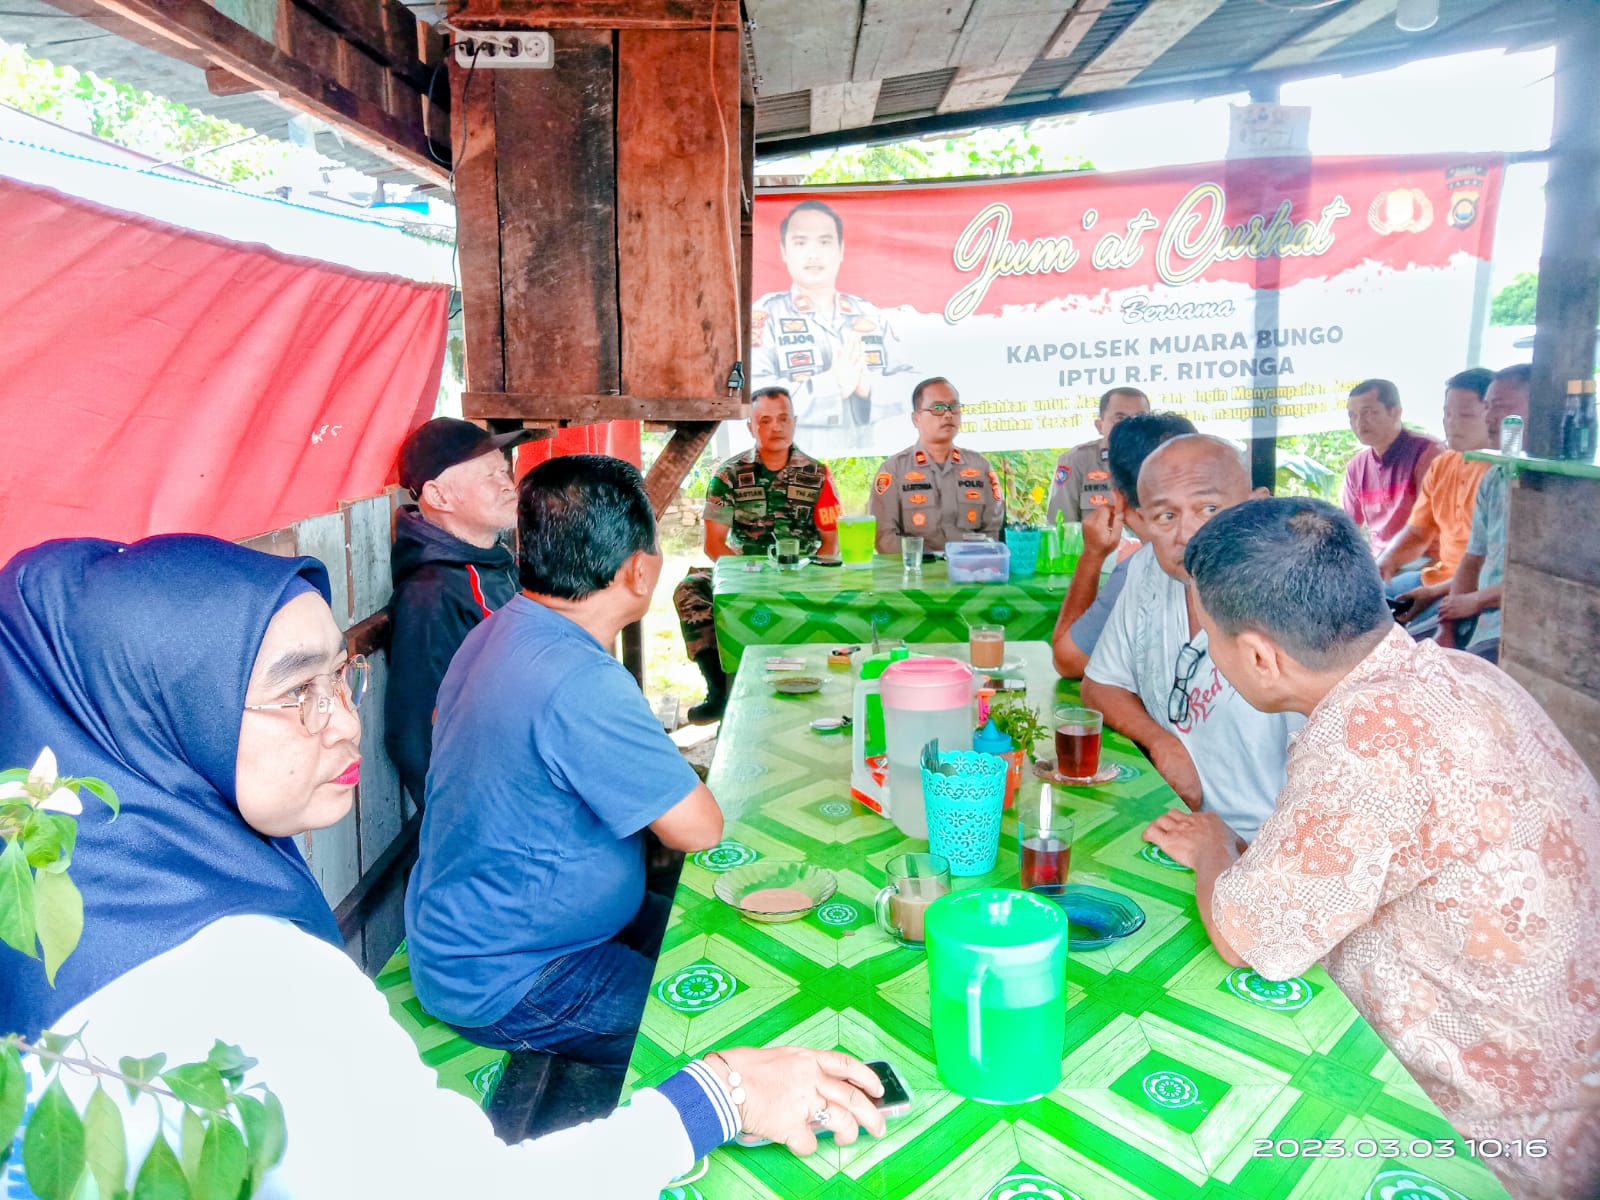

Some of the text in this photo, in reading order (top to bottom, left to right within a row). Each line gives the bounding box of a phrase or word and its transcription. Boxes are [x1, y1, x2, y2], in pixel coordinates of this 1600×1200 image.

[1157, 182, 1350, 286] Curhat
[1121, 295, 1235, 324] Bersama
[1006, 325, 1344, 363] KAPOLSEK MUARA BUNGO
[1058, 356, 1294, 387] IPTU R.F. RITONGA
[960, 400, 1028, 414] ersilahkan
[1032, 396, 1069, 411] untuk
[1194, 388, 1228, 405] Ingin
[1231, 381, 1327, 401] Menyampaikan
[981, 417, 1033, 432] Keluhan
[1213, 405, 1266, 422] maupun
[958, 480, 984, 488] POLRI
